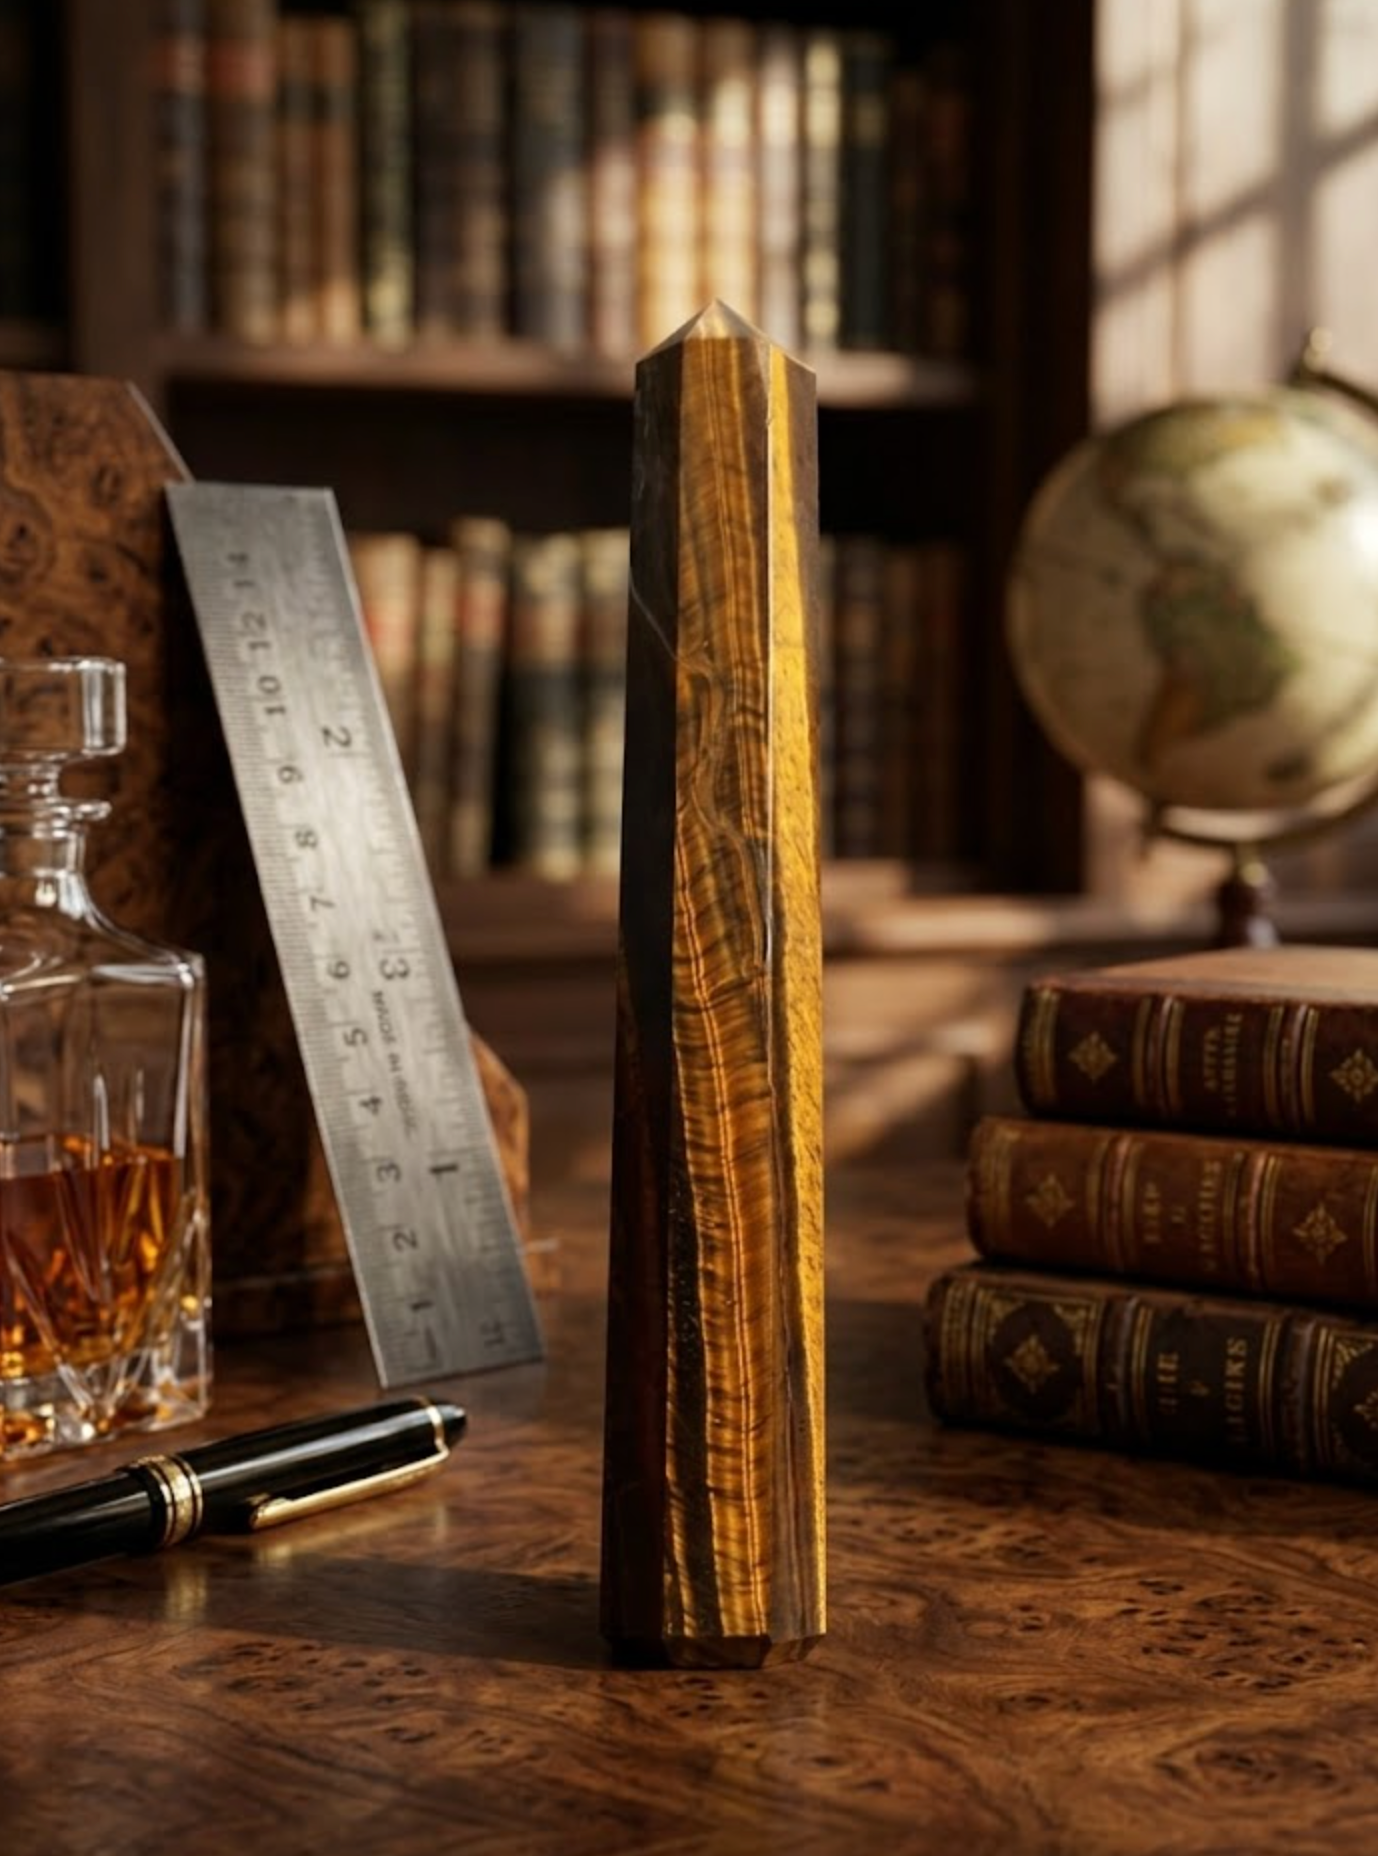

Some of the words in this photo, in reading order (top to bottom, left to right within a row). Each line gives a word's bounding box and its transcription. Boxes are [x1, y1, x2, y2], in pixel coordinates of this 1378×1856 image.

[256, 674, 288, 716] 10
[294, 828, 319, 849] 8
[308, 896, 336, 912] 7
[327, 959, 351, 981] 6
[342, 1027, 369, 1048] 5
[359, 1095, 382, 1116] 4
[376, 1159, 402, 1183] 3
[392, 1229, 418, 1252] 2
